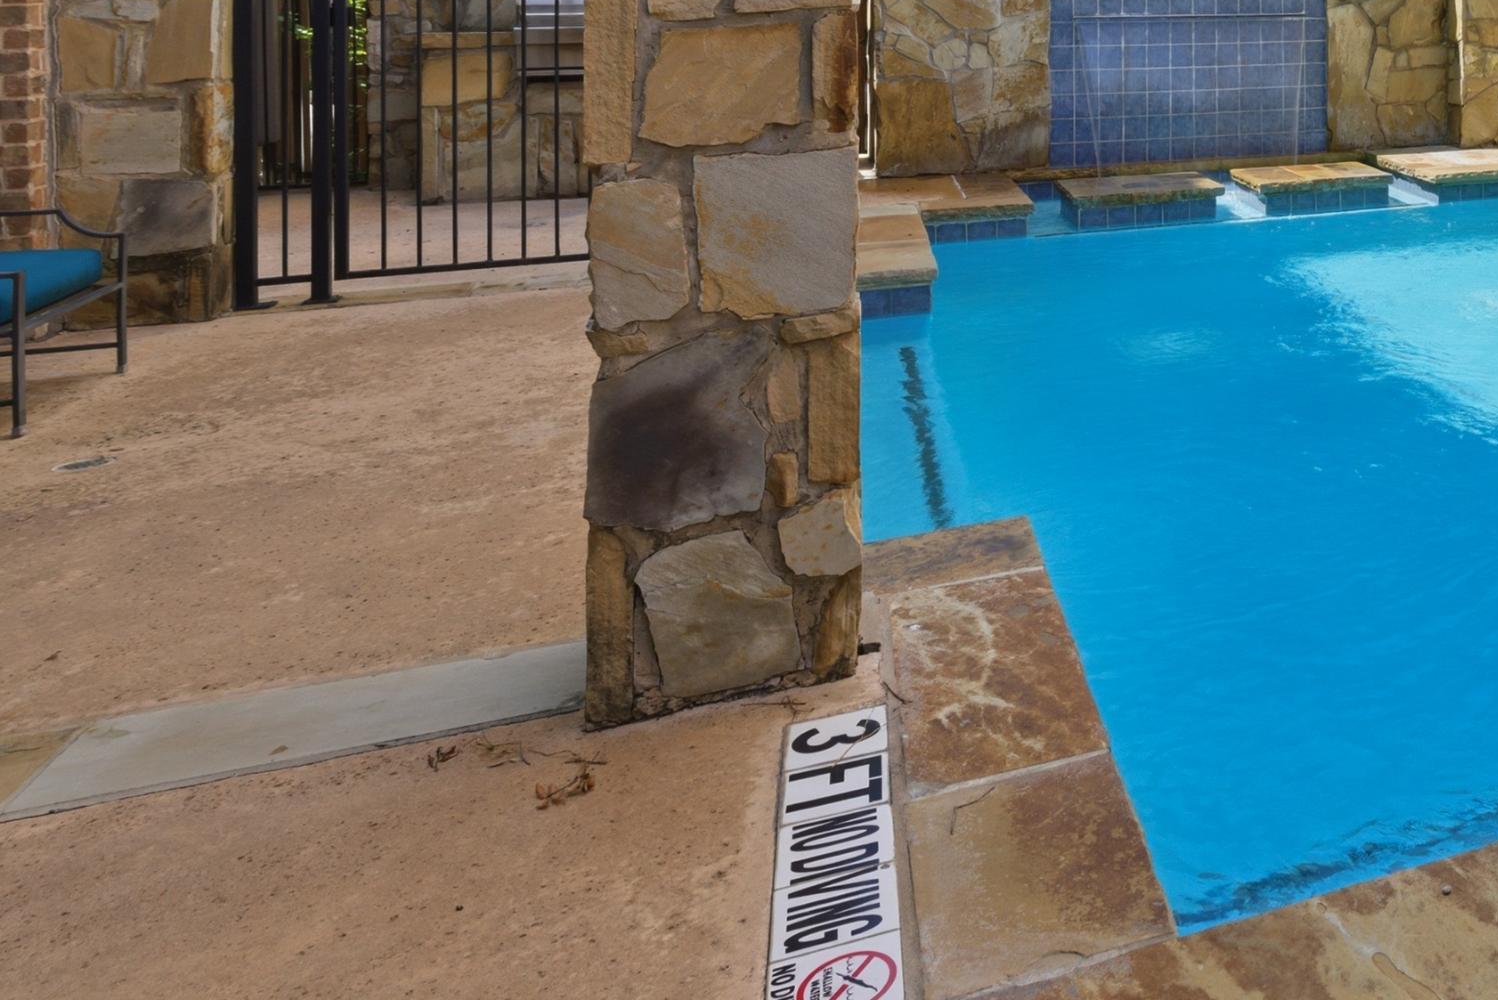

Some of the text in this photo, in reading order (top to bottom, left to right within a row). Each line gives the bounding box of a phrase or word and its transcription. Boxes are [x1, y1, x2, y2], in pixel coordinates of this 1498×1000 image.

[785, 719, 883, 814] 3 FT
[783, 808, 883, 954] NO DIVING
[771, 963, 796, 986] NO
